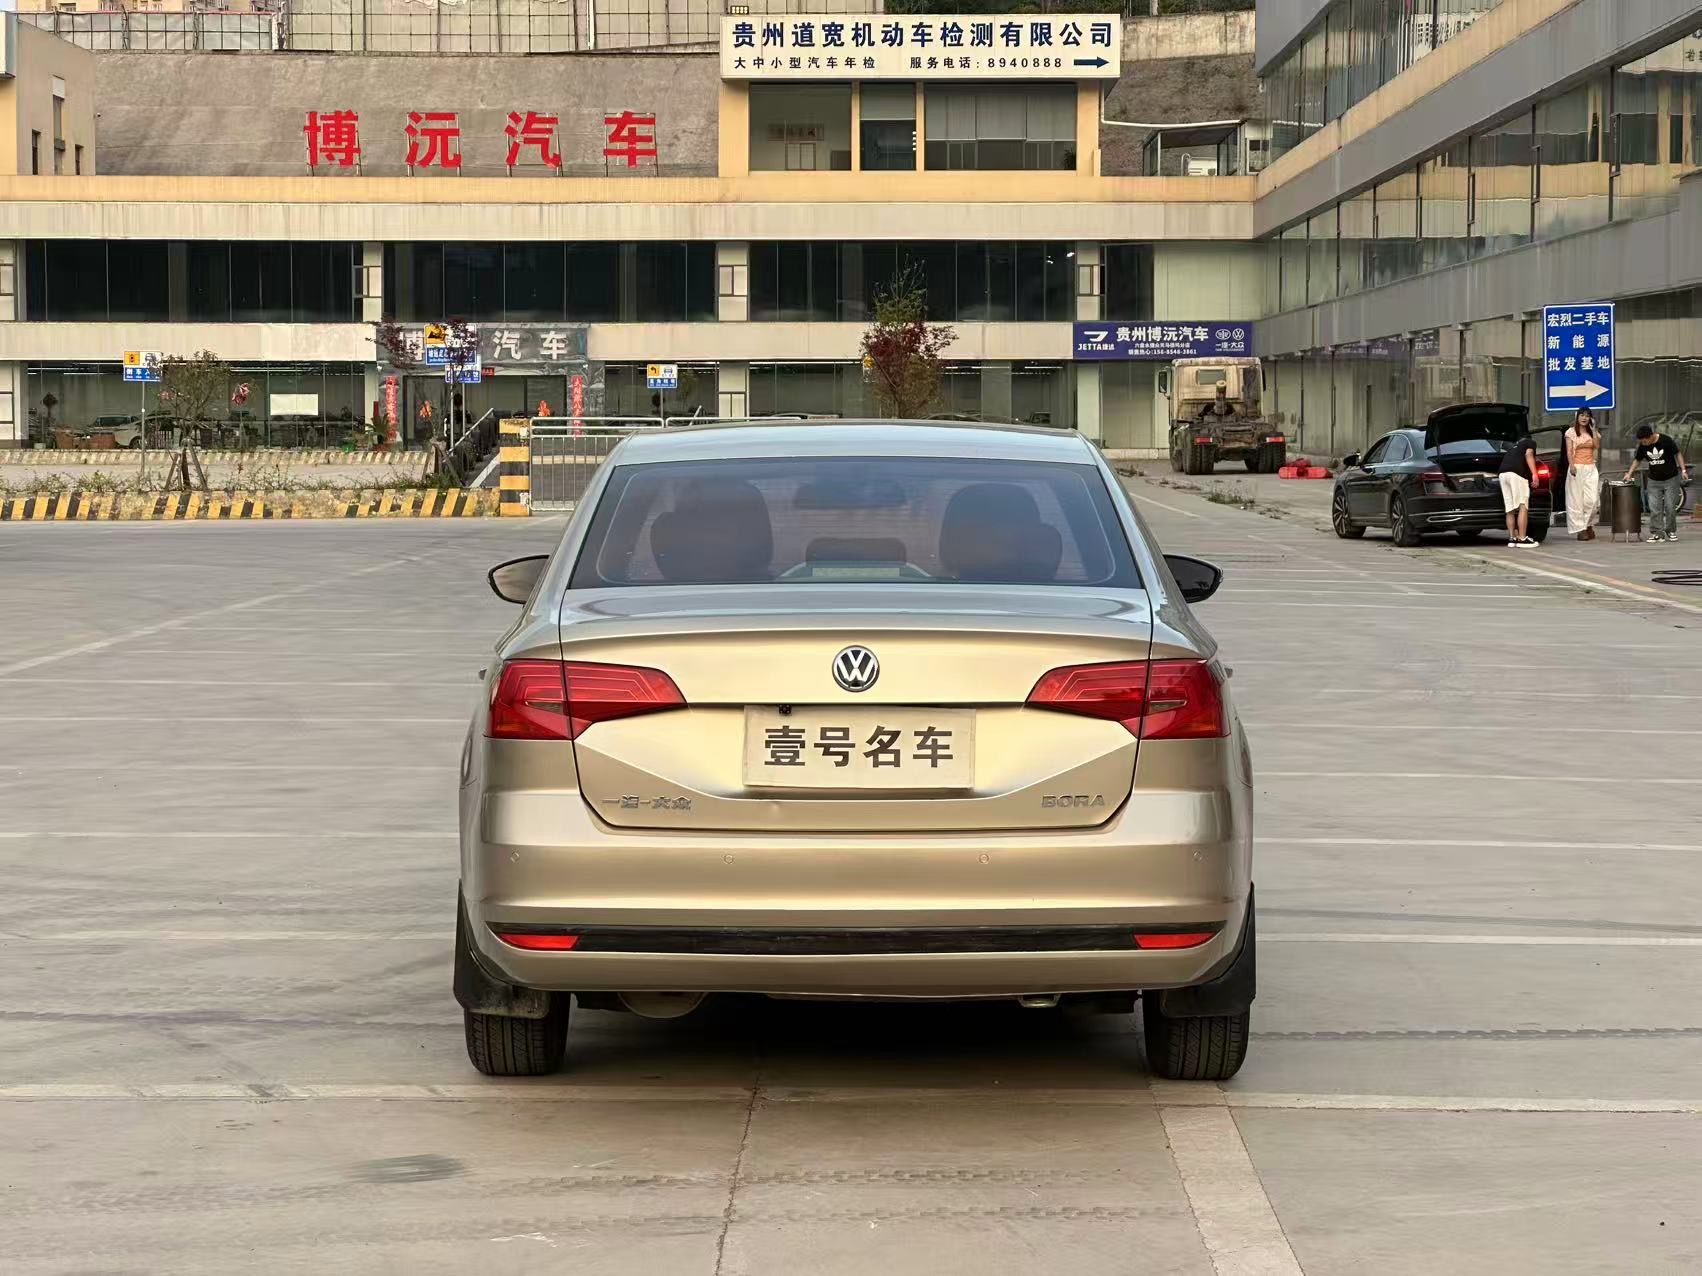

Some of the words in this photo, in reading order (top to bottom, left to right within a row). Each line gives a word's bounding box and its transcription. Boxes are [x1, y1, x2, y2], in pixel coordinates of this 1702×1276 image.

[732, 21, 1112, 48] 贵州道宽机动车检测有限公司
[734, 56, 875, 69] 大中小型汽车年检
[304, 109, 656, 168] 博沅汽车
[1547, 312, 1609, 327] 宏烈二手车
[1116, 326, 1209, 342] 贵州博沅汽车
[1548, 334, 1610, 349] 新能源
[1548, 356, 1610, 371] 批发基地
[763, 725, 954, 769] 壹号名车
[1041, 794, 1106, 808] BORA
